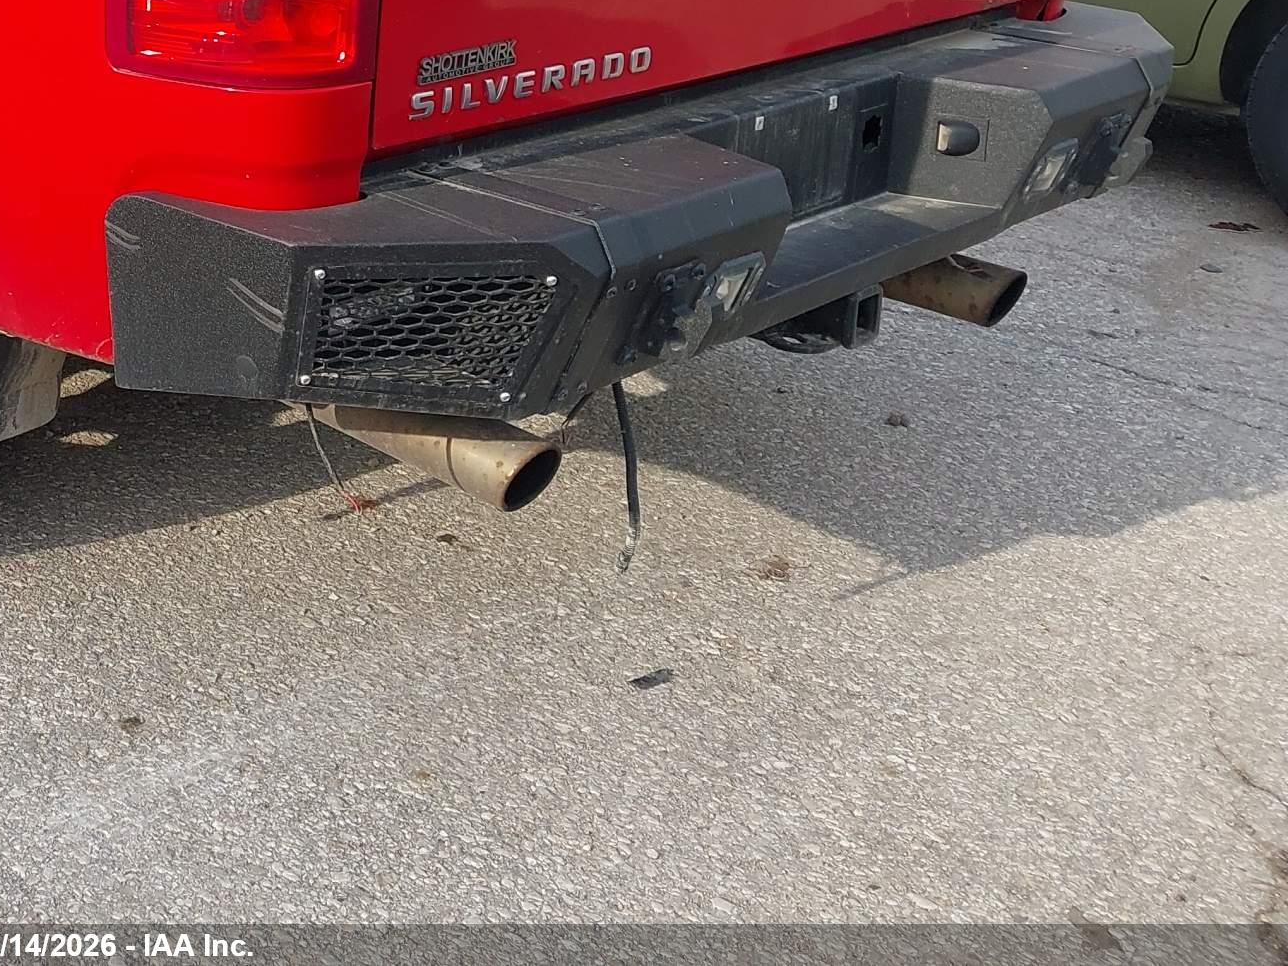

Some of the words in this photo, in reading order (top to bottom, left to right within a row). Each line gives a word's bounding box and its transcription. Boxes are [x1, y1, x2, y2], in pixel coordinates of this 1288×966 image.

[420, 39, 517, 77] SHOTTENKIRK
[425, 65, 480, 83] AUTOMOTIVE
[408, 46, 652, 121] SILVERADO
